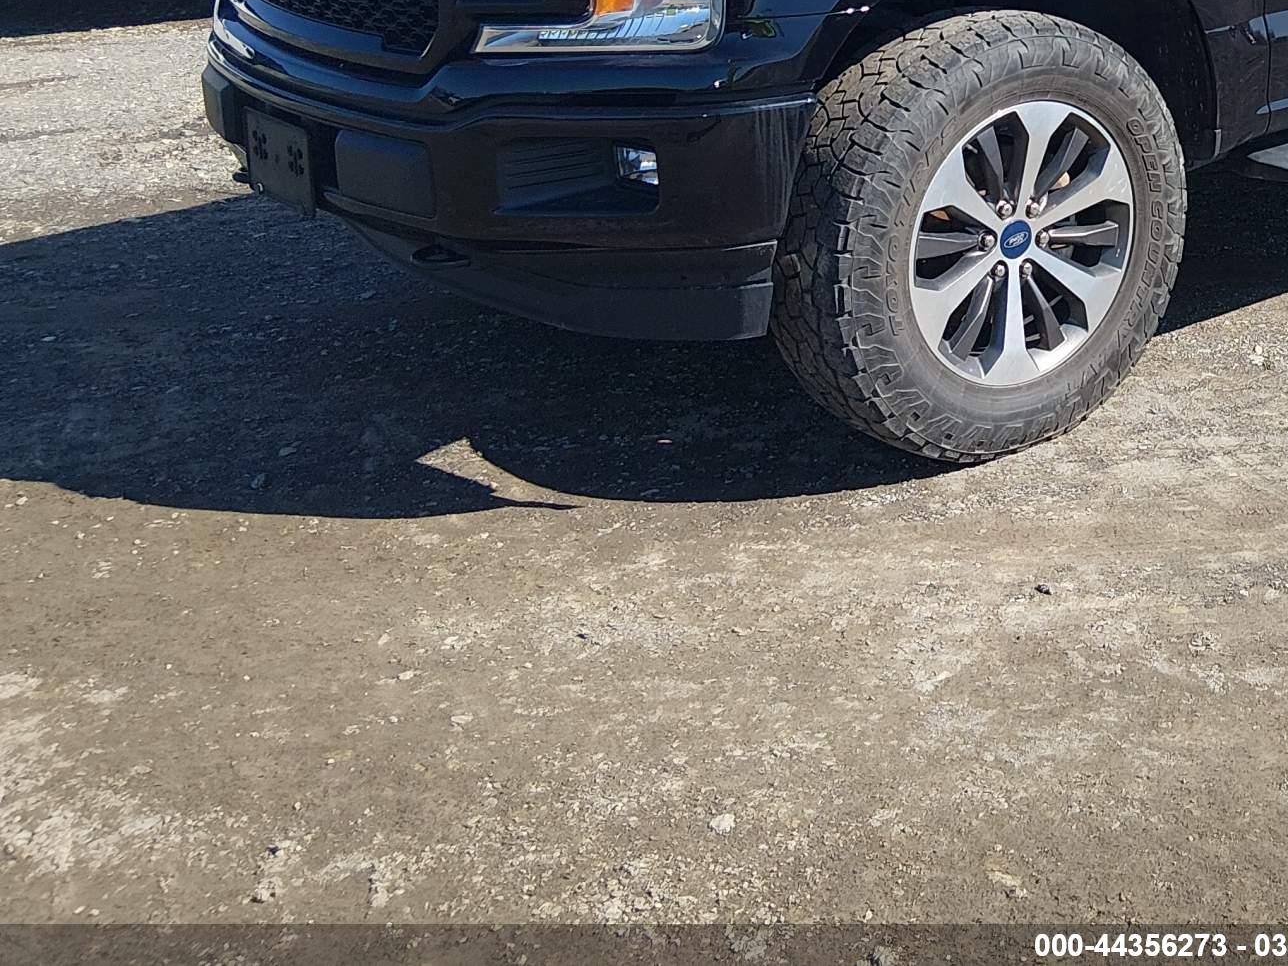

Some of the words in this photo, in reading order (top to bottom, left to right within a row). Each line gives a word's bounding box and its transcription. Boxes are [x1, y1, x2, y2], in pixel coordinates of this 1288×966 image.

[1126, 118, 1163, 194] OPEN
[885, 237, 904, 336] TOYO
[1116, 199, 1164, 349] COUNTRY
